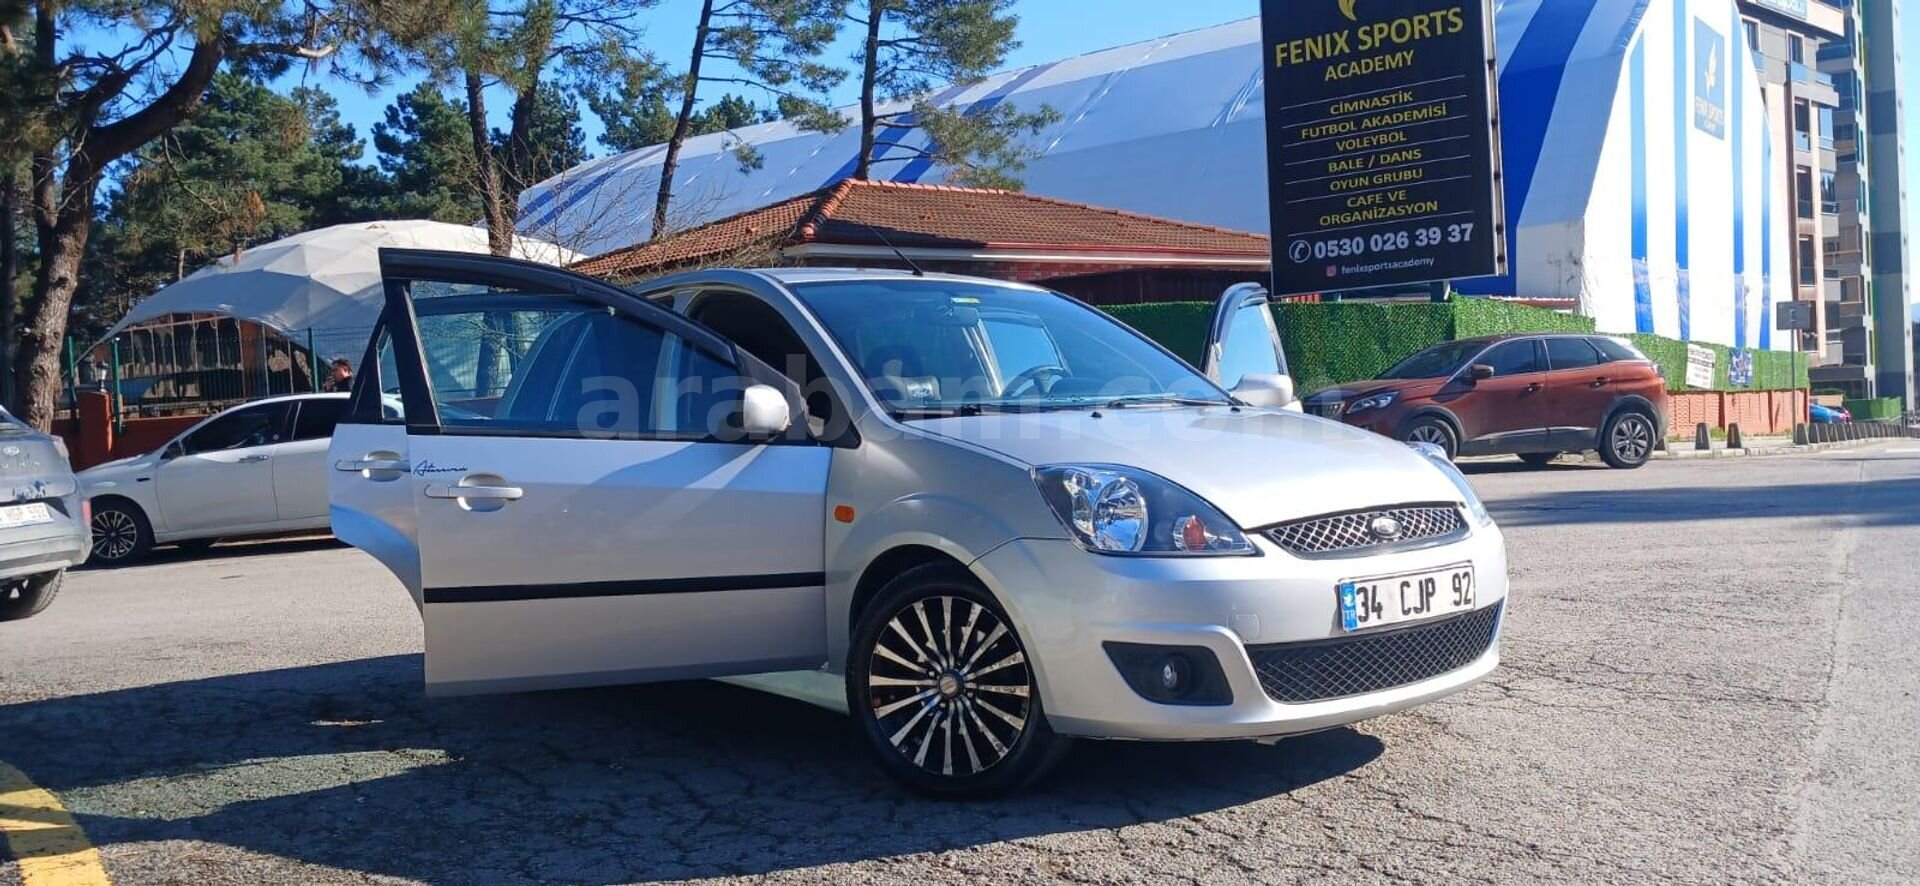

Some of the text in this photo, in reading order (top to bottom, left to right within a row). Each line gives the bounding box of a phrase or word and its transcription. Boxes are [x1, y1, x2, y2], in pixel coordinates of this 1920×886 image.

[1275, 8, 1464, 67] FENIX SPORTS
[1325, 50, 1414, 82] ACADEMY
[1302, 103, 1447, 139] FUTBOL AKADEMİSİ
[1336, 131, 1407, 152] VOLEYBOL
[1328, 157, 1364, 173] BALE
[1380, 149, 1422, 165] DANS
[1330, 168, 1423, 192] OYUN GRUBU
[1347, 190, 1407, 208] CAFE VE
[1319, 200, 1438, 227] ORGANİZASYON
[1314, 223, 1474, 259] 0530 026 39 37
[1341, 257, 1435, 275] fenixsportsacademy
[1356, 572, 1472, 623] 34 CJP 92
